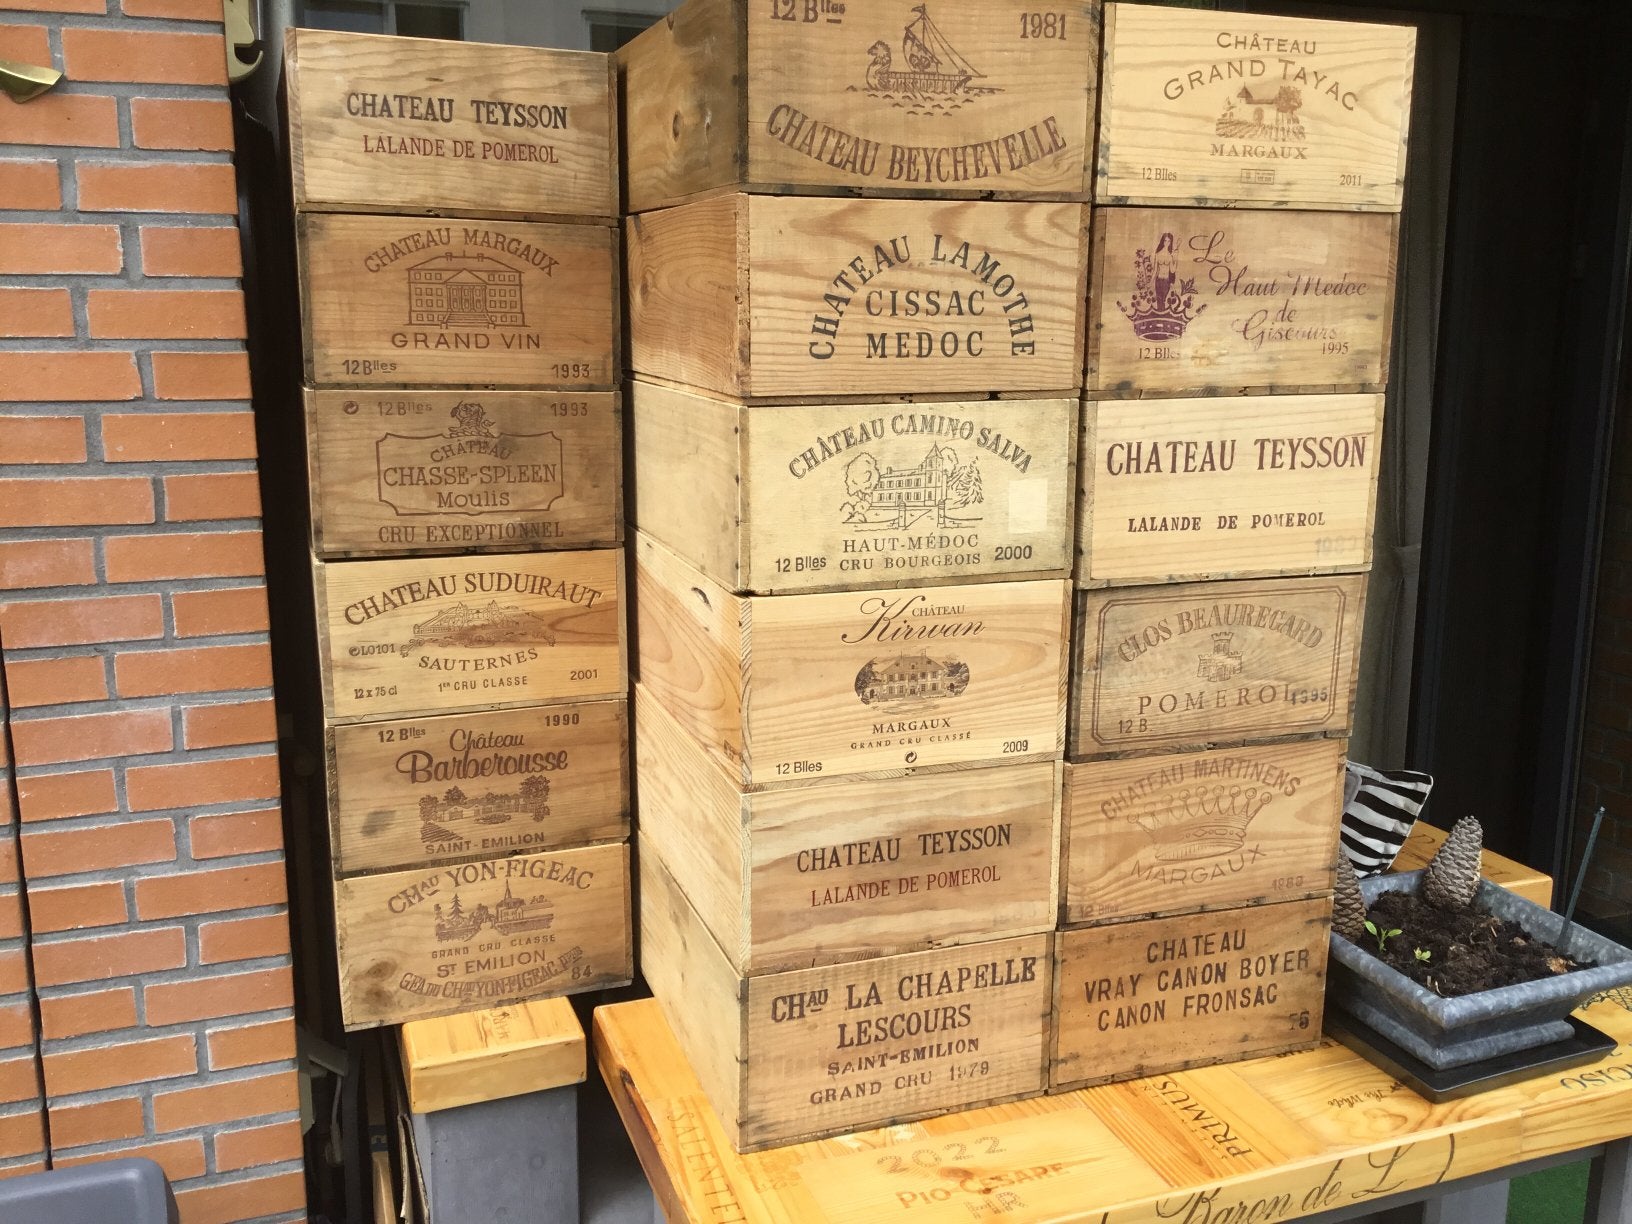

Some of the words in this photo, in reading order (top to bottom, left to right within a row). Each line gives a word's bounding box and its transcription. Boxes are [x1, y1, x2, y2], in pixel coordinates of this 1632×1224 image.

[1020, 12, 1067, 40] 1981
[1216, 31, 1317, 55] CHÂTEAU
[1163, 59, 1266, 101] GRAND
[1278, 58, 1359, 111] TAYAC
[346, 92, 454, 123] CHATEAU
[471, 100, 568, 129] TEYSSON
[363, 135, 445, 157] LALANDE
[453, 140, 475, 159] DE
[482, 142, 559, 163] POMEROL
[767, 103, 882, 177] CHATEAU
[886, 115, 1067, 183] BEYCHEVELLE
[1210, 143, 1309, 160] MARGAUX
[1141, 167, 1153, 180] 12
[1339, 174, 1362, 187] 2011
[364, 227, 451, 274] CHATEAU
[463, 228, 560, 277] MARGAUX
[1188, 230, 1236, 265] Le
[1209, 265, 1280, 297] Haut
[808, 235, 912, 361] CHATEAU
[931, 233, 1035, 358] LAMOTHE
[865, 289, 985, 317] CISSAC
[1276, 299, 1297, 323] de
[391, 333, 490, 349] GRAND
[500, 334, 540, 349] VIN
[1231, 309, 1337, 351] Giscours
[866, 330, 984, 359] MEDOC
[1138, 347, 1151, 360] 12
[1321, 342, 1349, 355] 1995
[551, 364, 590, 378] 1993
[550, 402, 588, 417] 1993
[430, 439, 513, 463] CHÂTEAU
[788, 416, 886, 480] CHÂTEAU
[891, 413, 975, 442] CAMINO
[977, 427, 1034, 474] SALVA
[1106, 439, 1237, 476] CHATEAU
[1254, 436, 1367, 471] TEYSSON
[383, 463, 557, 487] CHASSE-SPLEEN
[436, 491, 511, 509] Moulis
[378, 525, 416, 544] CRU
[426, 521, 564, 543] EXCEPTIONNEL
[1127, 515, 1201, 533] LALANDE
[1217, 515, 1238, 530] DE
[1250, 511, 1326, 529] POMEROL
[842, 532, 980, 554] HAUT-MÉDOC
[994, 545, 1033, 561] 2000
[775, 557, 791, 573] 12
[839, 557, 874, 571] CRU
[884, 553, 981, 569] BOURGEOIS
[344, 575, 457, 626] CHATEAU
[464, 572, 605, 609] SUDUIRAUT
[911, 603, 967, 618] CHÂTEAU
[841, 595, 986, 644] Kirwan
[1117, 618, 1173, 663] CLOS
[1176, 603, 1323, 648] BEAUREGARD
[418, 647, 539, 672] SAUTERNES
[453, 679, 477, 691] CRU
[483, 676, 528, 689] CLASSE
[570, 668, 599, 681] 2001
[375, 686, 386, 697] 75
[388, 685, 398, 696] cl
[544, 713, 580, 727] 1990
[872, 717, 952, 735] MARGAUX
[1118, 719, 1133, 734] 12
[378, 730, 395, 743] 12
[450, 728, 525, 751] Château
[850, 738, 891, 750] GRAND
[899, 736, 922, 746] CRU
[929, 731, 971, 743] CLASSÉ
[1002, 740, 1029, 754] 2009
[396, 749, 568, 784] Barberousse
[775, 762, 790, 775] 12
[793, 760, 823, 774] Blles
[1100, 763, 1185, 820] CHATEAU
[1194, 758, 1301, 797] MARTINENS
[797, 837, 901, 873] CHATEAU
[918, 823, 1013, 856] TEYSSON
[445, 859, 594, 890] YON-FIGEAC
[1131, 843, 1267, 885] MARGAUX
[811, 879, 890, 907] LALANDE
[898, 876, 919, 895] DE
[926, 865, 1001, 891] POMEROL
[431, 947, 469, 959] GRAND
[479, 943, 501, 952] CRU
[511, 934, 556, 945] CLASSE
[1146, 928, 1246, 964] CHATEAU
[465, 950, 546, 974] EMILION
[571, 964, 592, 980] 84
[845, 981, 883, 1011] LA
[898, 956, 1037, 1002] CHAPELLE
[1084, 973, 1143, 1004] VRAY
[1157, 961, 1227, 992] CANON
[1240, 949, 1310, 980] BOYER
[1097, 1000, 1166, 1032] CANON
[1182, 983, 1278, 1018] FRONSAC
[836, 1004, 972, 1050] LESCOURS
[827, 1038, 979, 1076] SAINT-EMILION
[809, 1081, 882, 1105] GRAND
[894, 1071, 932, 1090] CRU
[1153, 1081, 1254, 1157] PRIMUS
[877, 1136, 1006, 1174] 2022
[1301, 1158, 1343, 1213] de
[896, 1188, 952, 1209] PIO
